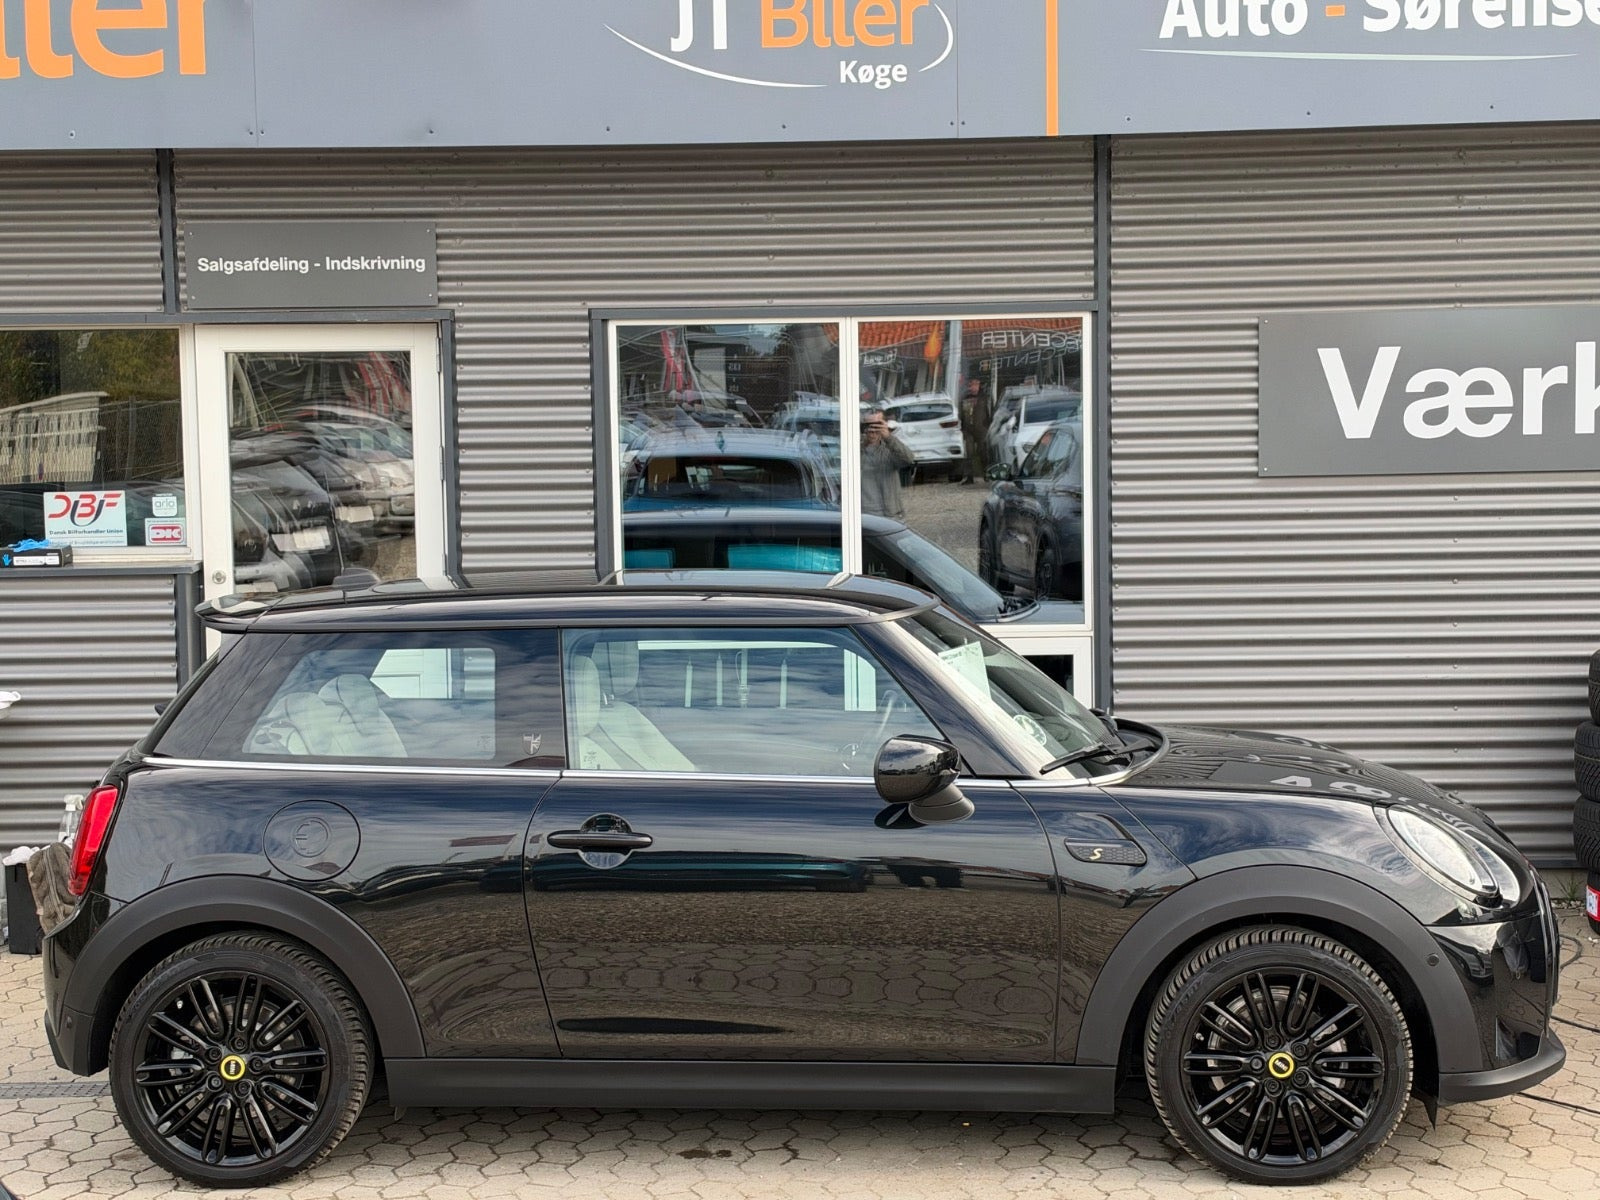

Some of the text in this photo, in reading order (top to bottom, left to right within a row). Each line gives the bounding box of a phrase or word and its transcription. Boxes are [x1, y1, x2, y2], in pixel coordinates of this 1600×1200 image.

[1158, 0, 1309, 39] Auto
[839, 60, 908, 90] Køge
[197, 257, 309, 275] Salgsafdeling
[325, 255, 426, 273] Indskrivning
